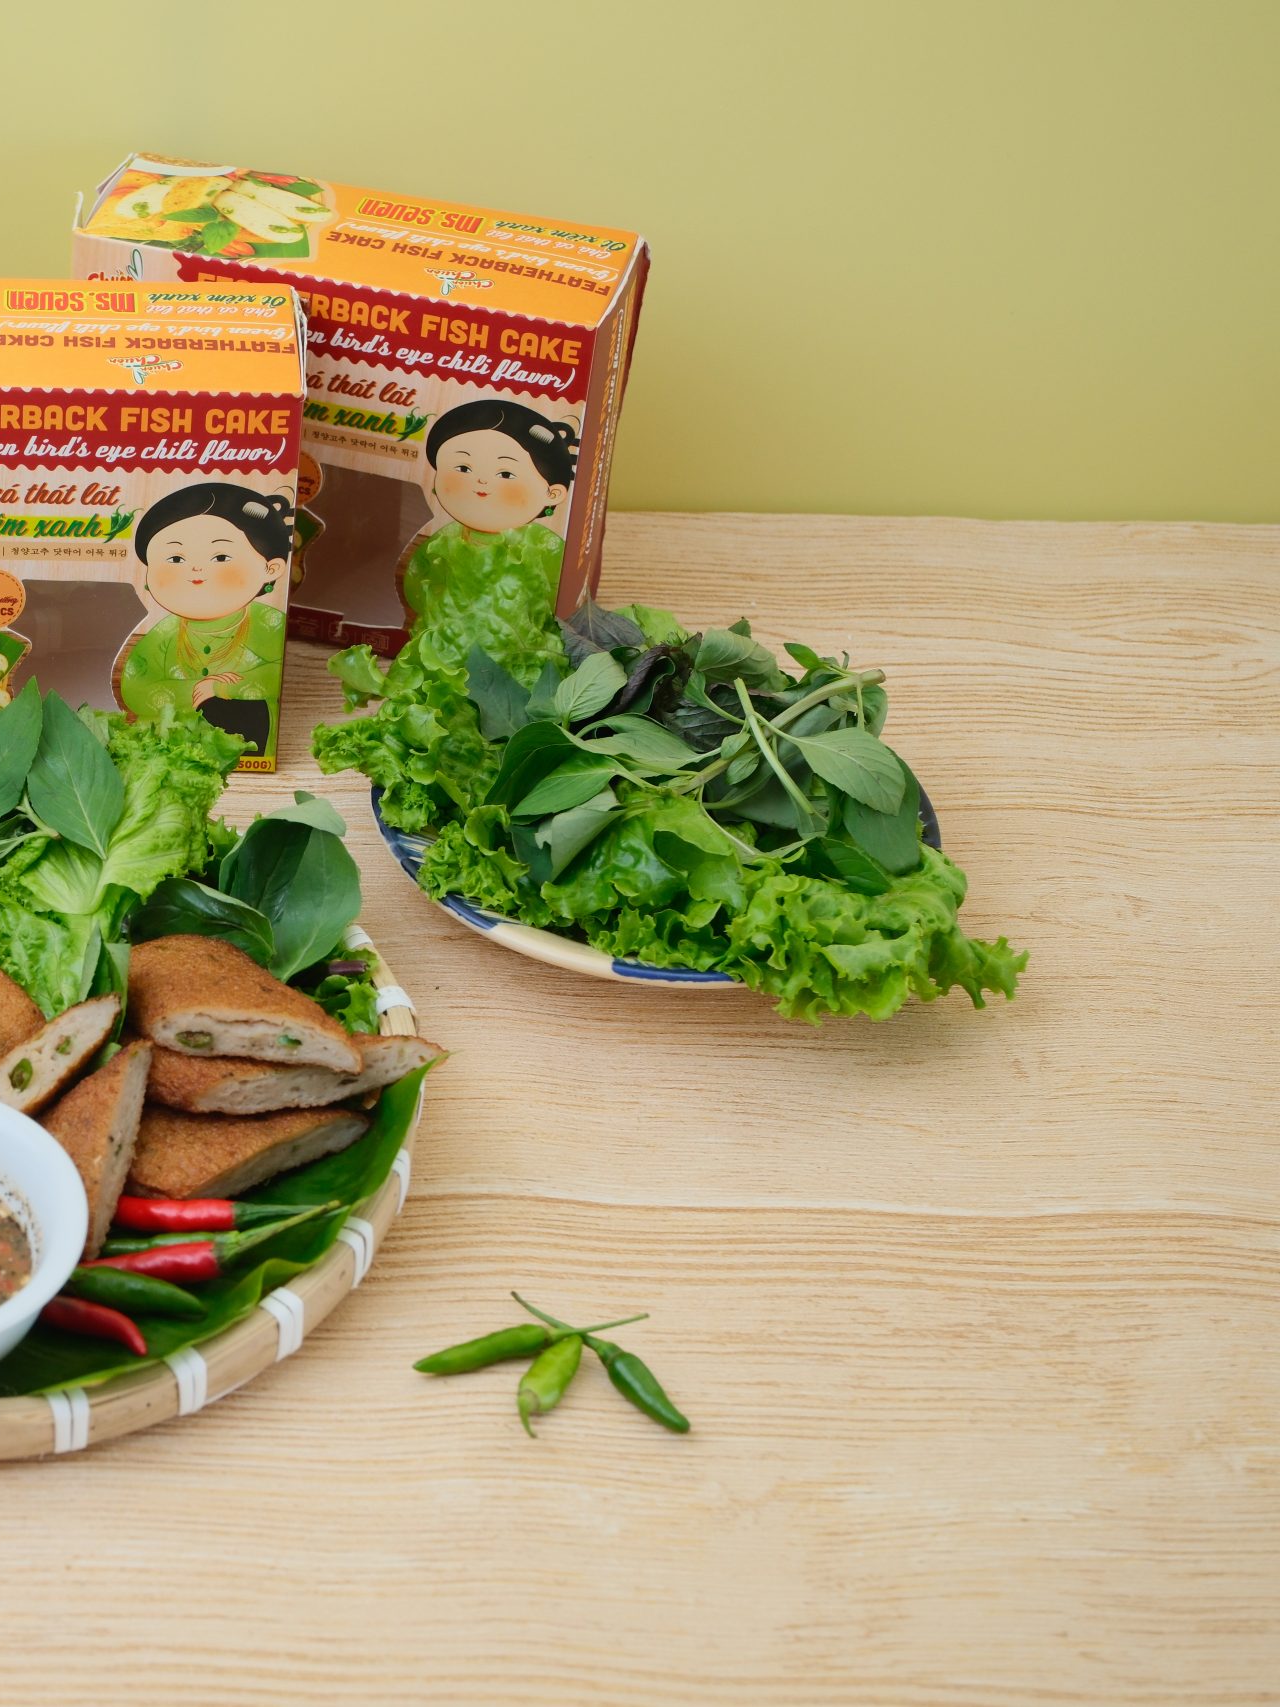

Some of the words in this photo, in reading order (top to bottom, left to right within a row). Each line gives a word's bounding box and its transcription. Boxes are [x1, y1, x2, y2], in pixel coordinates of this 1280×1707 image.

[496, 220, 546, 234] xanh
[326, 231, 385, 249] CAKE
[408, 234, 455, 247] chili
[458, 243, 491, 253] eye
[391, 242, 443, 260] FISH
[448, 253, 611, 296] FEATHERBACK
[553, 260, 618, 282] (Green
[148, 293, 201, 303] xanh
[72, 323, 120, 334] chili
[126, 323, 160, 333] eye
[167, 325, 222, 336] bird's
[228, 327, 295, 341] (Green
[63, 336, 116, 348] FISH
[125, 337, 296, 354] FEATHERBACK
[420, 314, 490, 349] FISH
[500, 328, 582, 365] CAKE
[330, 327, 392, 357] bird's
[395, 347, 434, 366] eye
[437, 349, 492, 375] chili
[491, 358, 576, 393] flavor)
[120, 407, 192, 433] FISH
[205, 409, 290, 435] CAKE
[334, 409, 398, 435] xanh
[24, 436, 91, 457] bird's
[95, 444, 137, 463] eye
[141, 438, 197, 460] chili
[198, 437, 286, 465] flavor)
[24, 482, 77, 505] thát
[80, 482, 121, 505] lát
[33, 513, 103, 538] xanh
